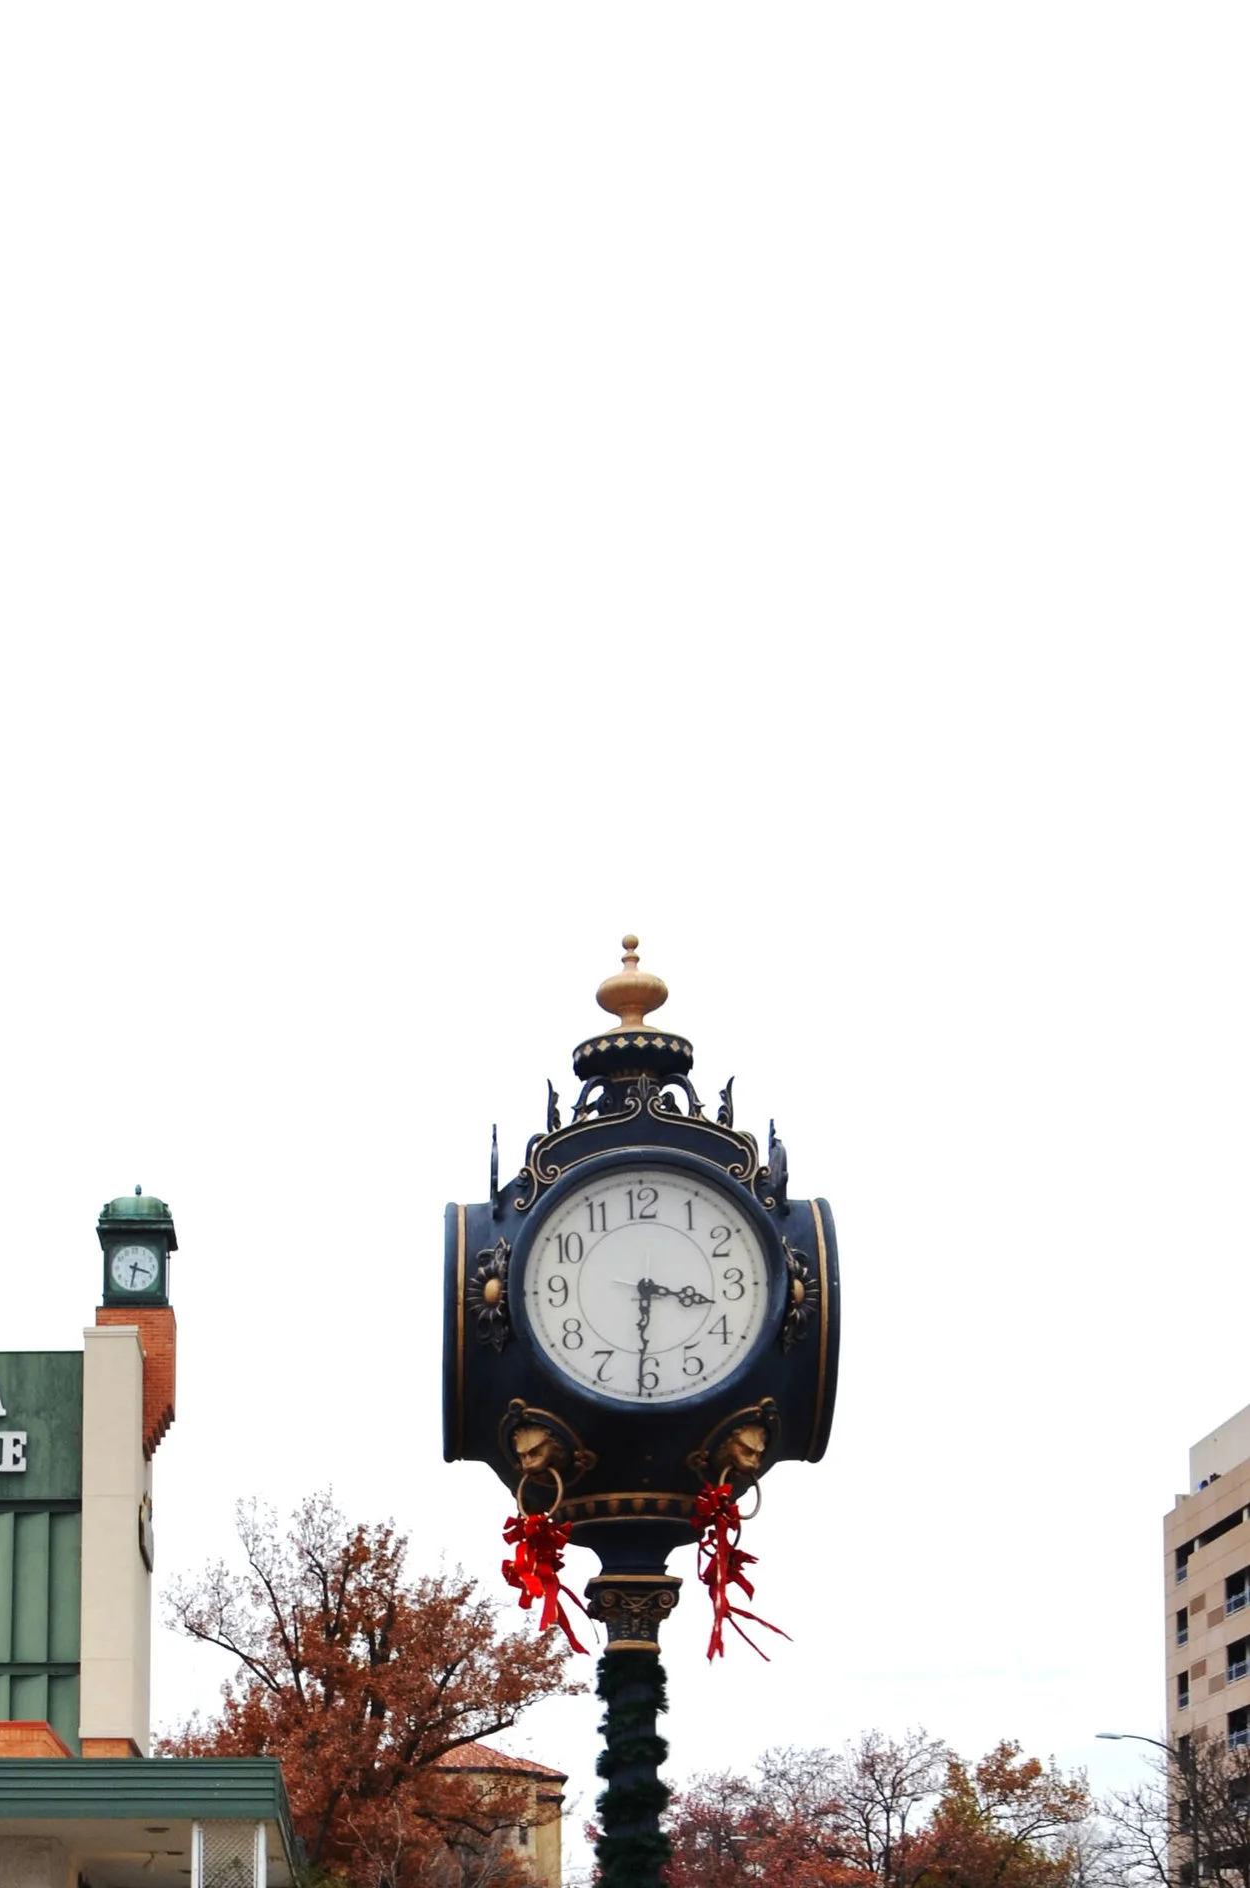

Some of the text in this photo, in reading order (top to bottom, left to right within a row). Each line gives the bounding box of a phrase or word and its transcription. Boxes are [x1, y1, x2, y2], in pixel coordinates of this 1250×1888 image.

[586, 1200, 608, 1233] 11
[625, 1187, 659, 1221] 12
[684, 1199, 695, 1231] 1
[554, 1232, 584, 1264] 10
[710, 1225, 732, 1258] 2
[547, 1275, 569, 1307] 9
[722, 1268, 745, 1301] 3
[562, 1318, 583, 1350] 8
[708, 1314, 733, 1345] 4
[591, 1350, 615, 1382] 7
[640, 1357, 660, 1390] 6
[682, 1341, 704, 1376] 5
